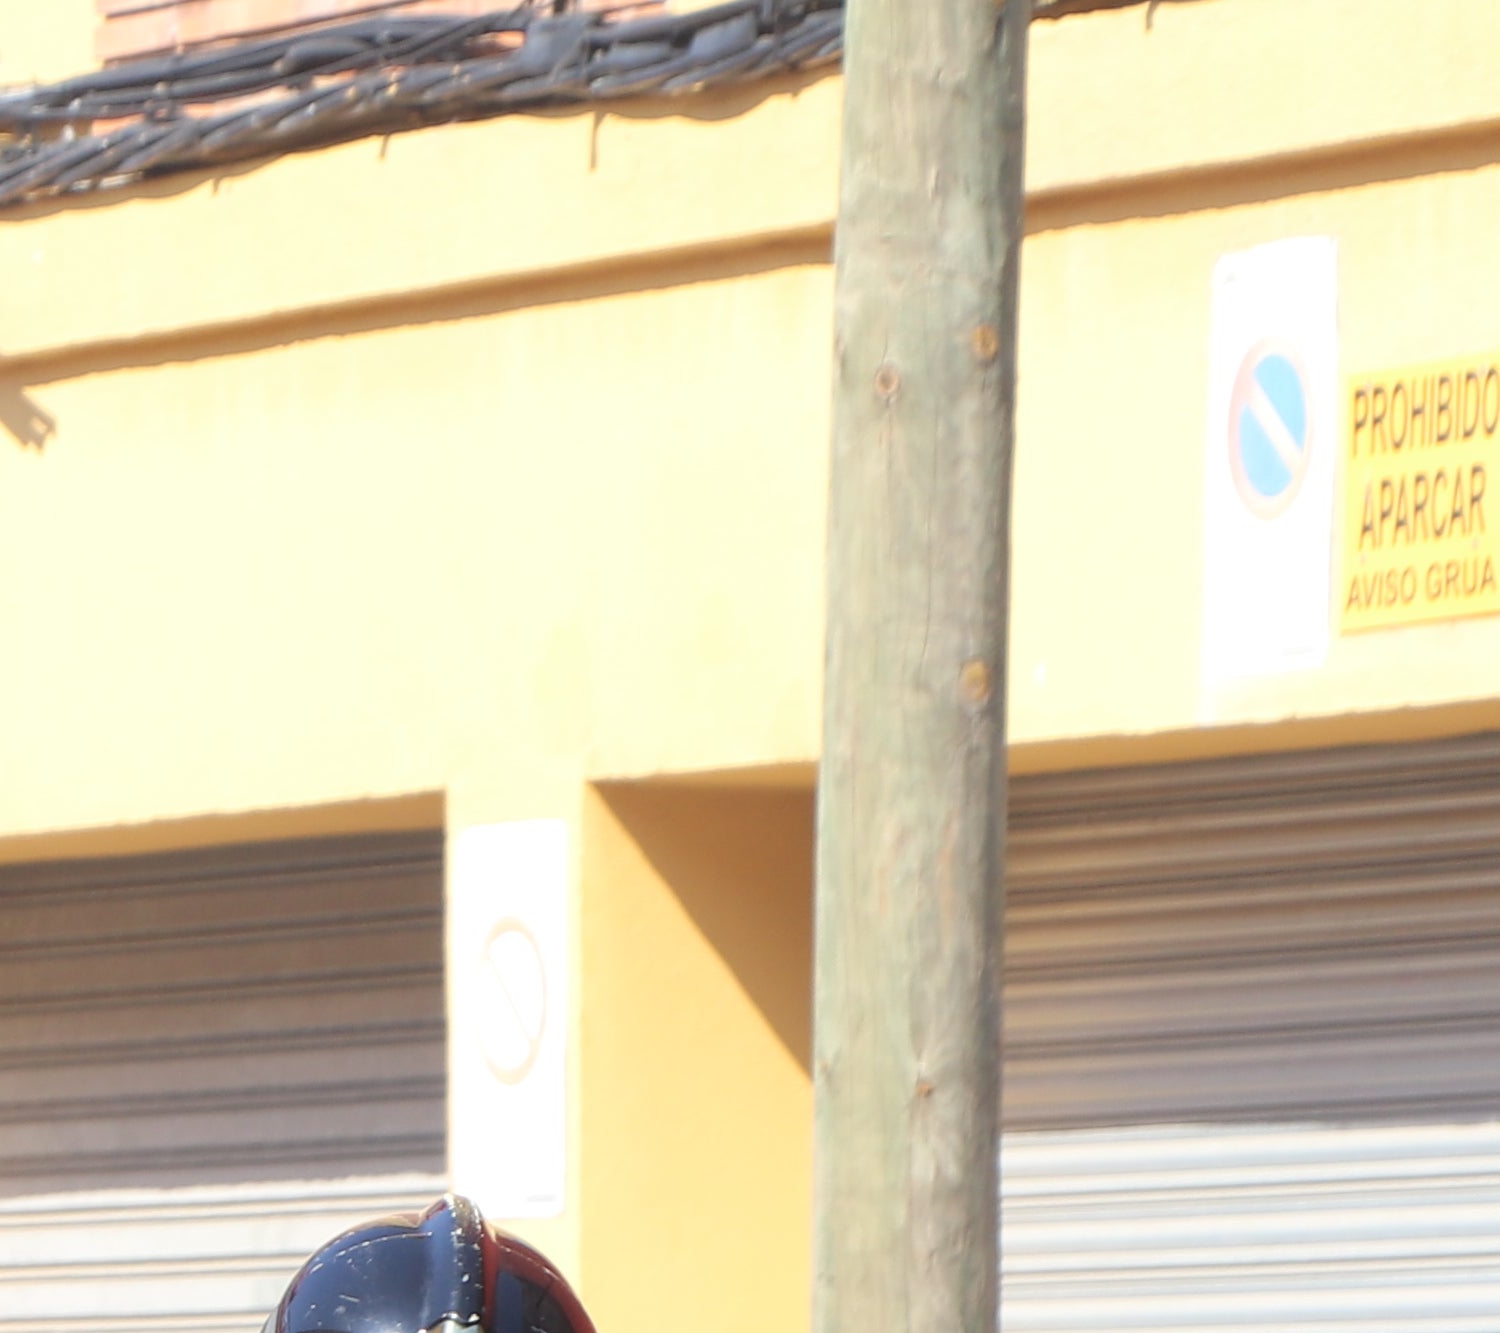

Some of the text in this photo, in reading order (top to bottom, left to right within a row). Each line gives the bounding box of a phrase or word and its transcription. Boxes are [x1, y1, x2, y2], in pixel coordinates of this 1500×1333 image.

[1357, 461, 1488, 551] APARCAR
[1345, 554, 1499, 614] AVISO GRUA
